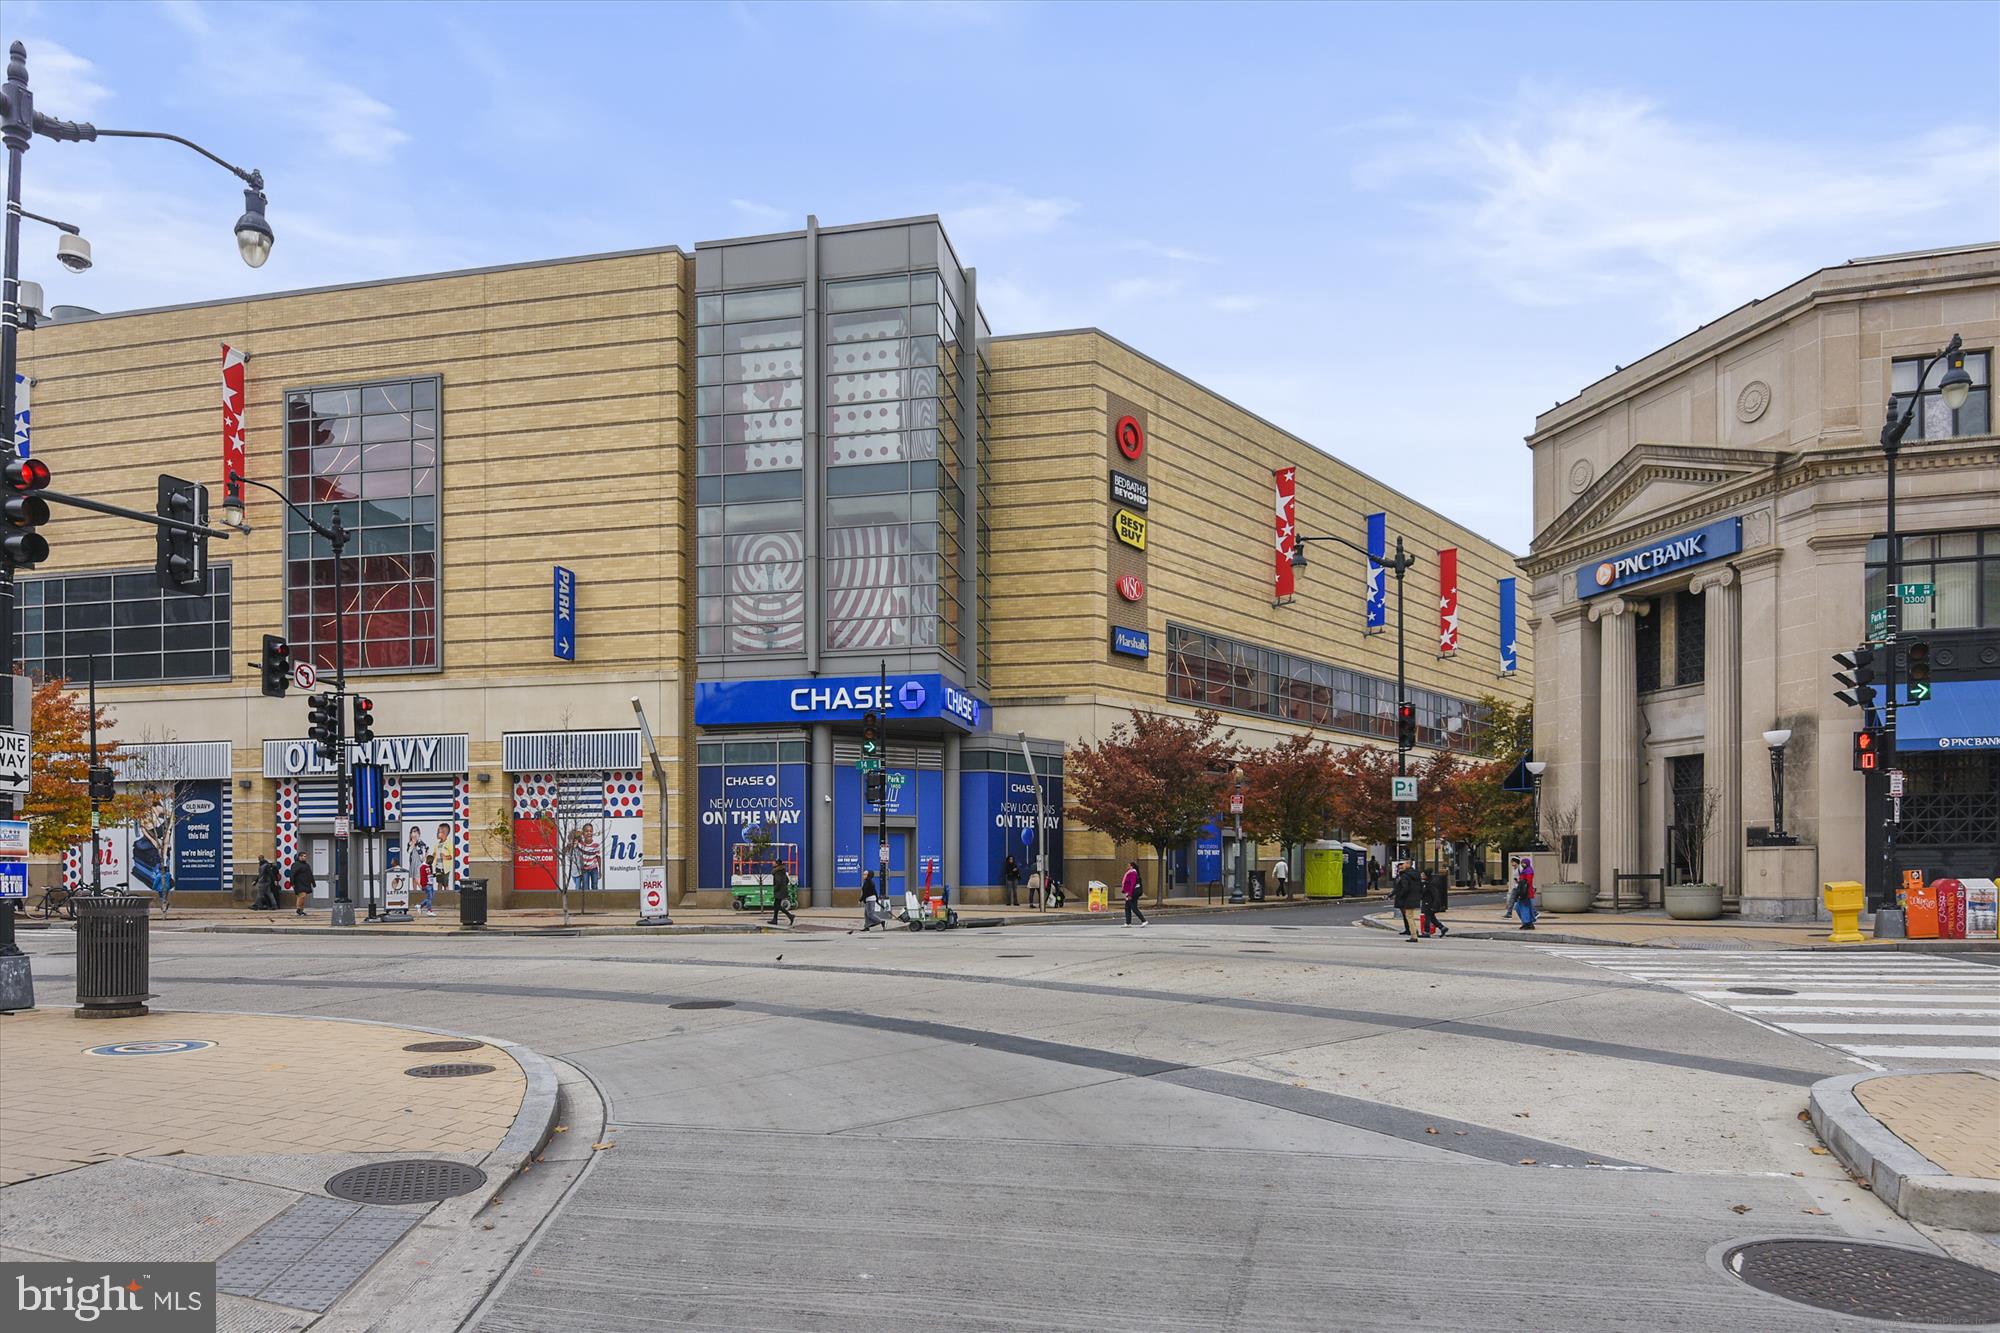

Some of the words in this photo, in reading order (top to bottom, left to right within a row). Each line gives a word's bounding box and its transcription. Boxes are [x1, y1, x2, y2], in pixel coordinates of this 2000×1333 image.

[1115, 486, 1148, 504] BEYOND
[1121, 514, 1144, 533] BEST
[1121, 526, 1141, 543] BUY
[1614, 552, 1651, 579] PNC
[1653, 534, 1705, 567] BANK
[559, 569, 570, 622] PARK
[1904, 585, 1915, 595] 14
[1116, 633, 1147, 651] Marshalls
[791, 685, 893, 711] CHASE
[946, 688, 973, 721] CHASE
[1951, 738, 1974, 747] PNC
[352, 738, 440, 771] NAVY
[1862, 753, 1875, 768] 10
[726, 776, 764, 786] CHASE
[888, 775, 900, 783] Park
[1011, 784, 1036, 793] CHASE
[710, 798, 733, 809] NEW
[736, 797, 794, 808] LOCATIONS
[1001, 803, 1017, 812] NEW
[702, 811, 727, 825] ON
[731, 811, 760, 825] THE
[765, 810, 801, 824] WAY
[996, 814, 1013, 828] ON
[1015, 815, 1035, 828] THE
[187, 824, 210, 832] opening
[188, 832, 199, 840] this
[199, 832, 209, 840] fall
[181, 849, 196, 857] we're
[196, 849, 216, 858] hiring!
[609, 833, 643, 863] hi,
[643, 881, 663, 889] PARK
